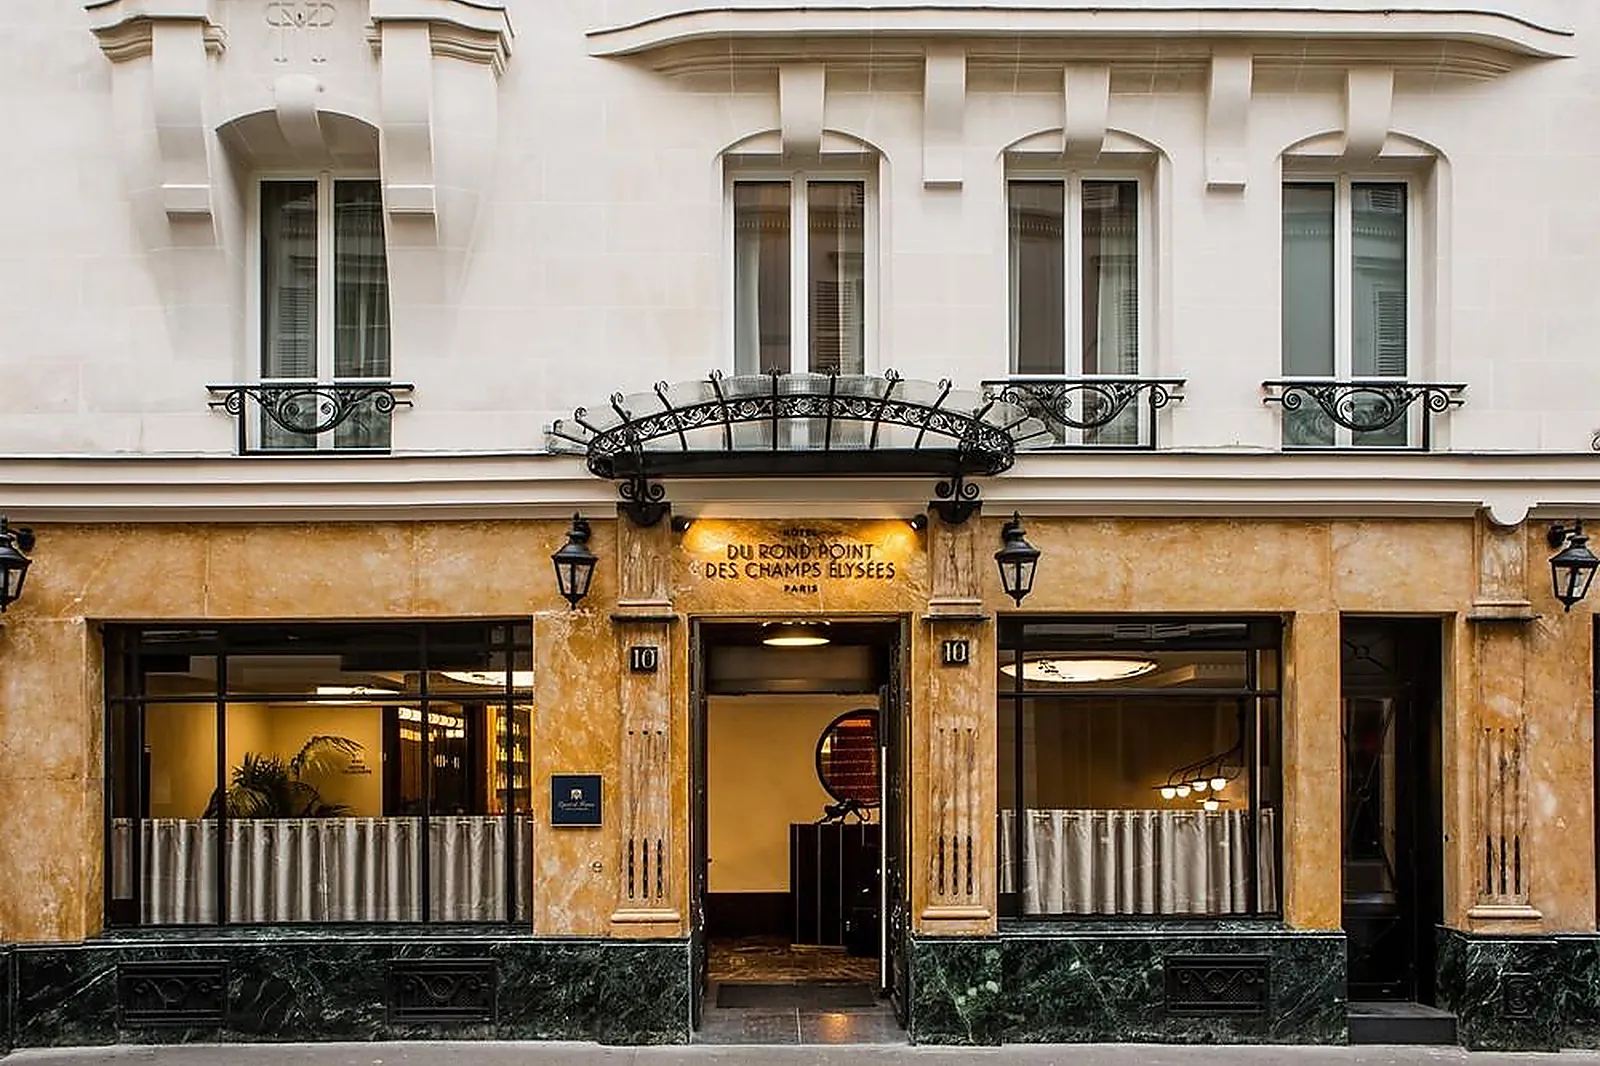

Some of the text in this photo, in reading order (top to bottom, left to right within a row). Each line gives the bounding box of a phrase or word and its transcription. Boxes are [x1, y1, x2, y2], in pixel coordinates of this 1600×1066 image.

[727, 544, 873, 560] DU ROND POINT
[706, 562, 737, 578] DES
[745, 562, 821, 578] CHAMPS
[784, 584, 818, 593] PARIS
[634, 649, 656, 669] 10
[945, 641, 966, 662] 10
